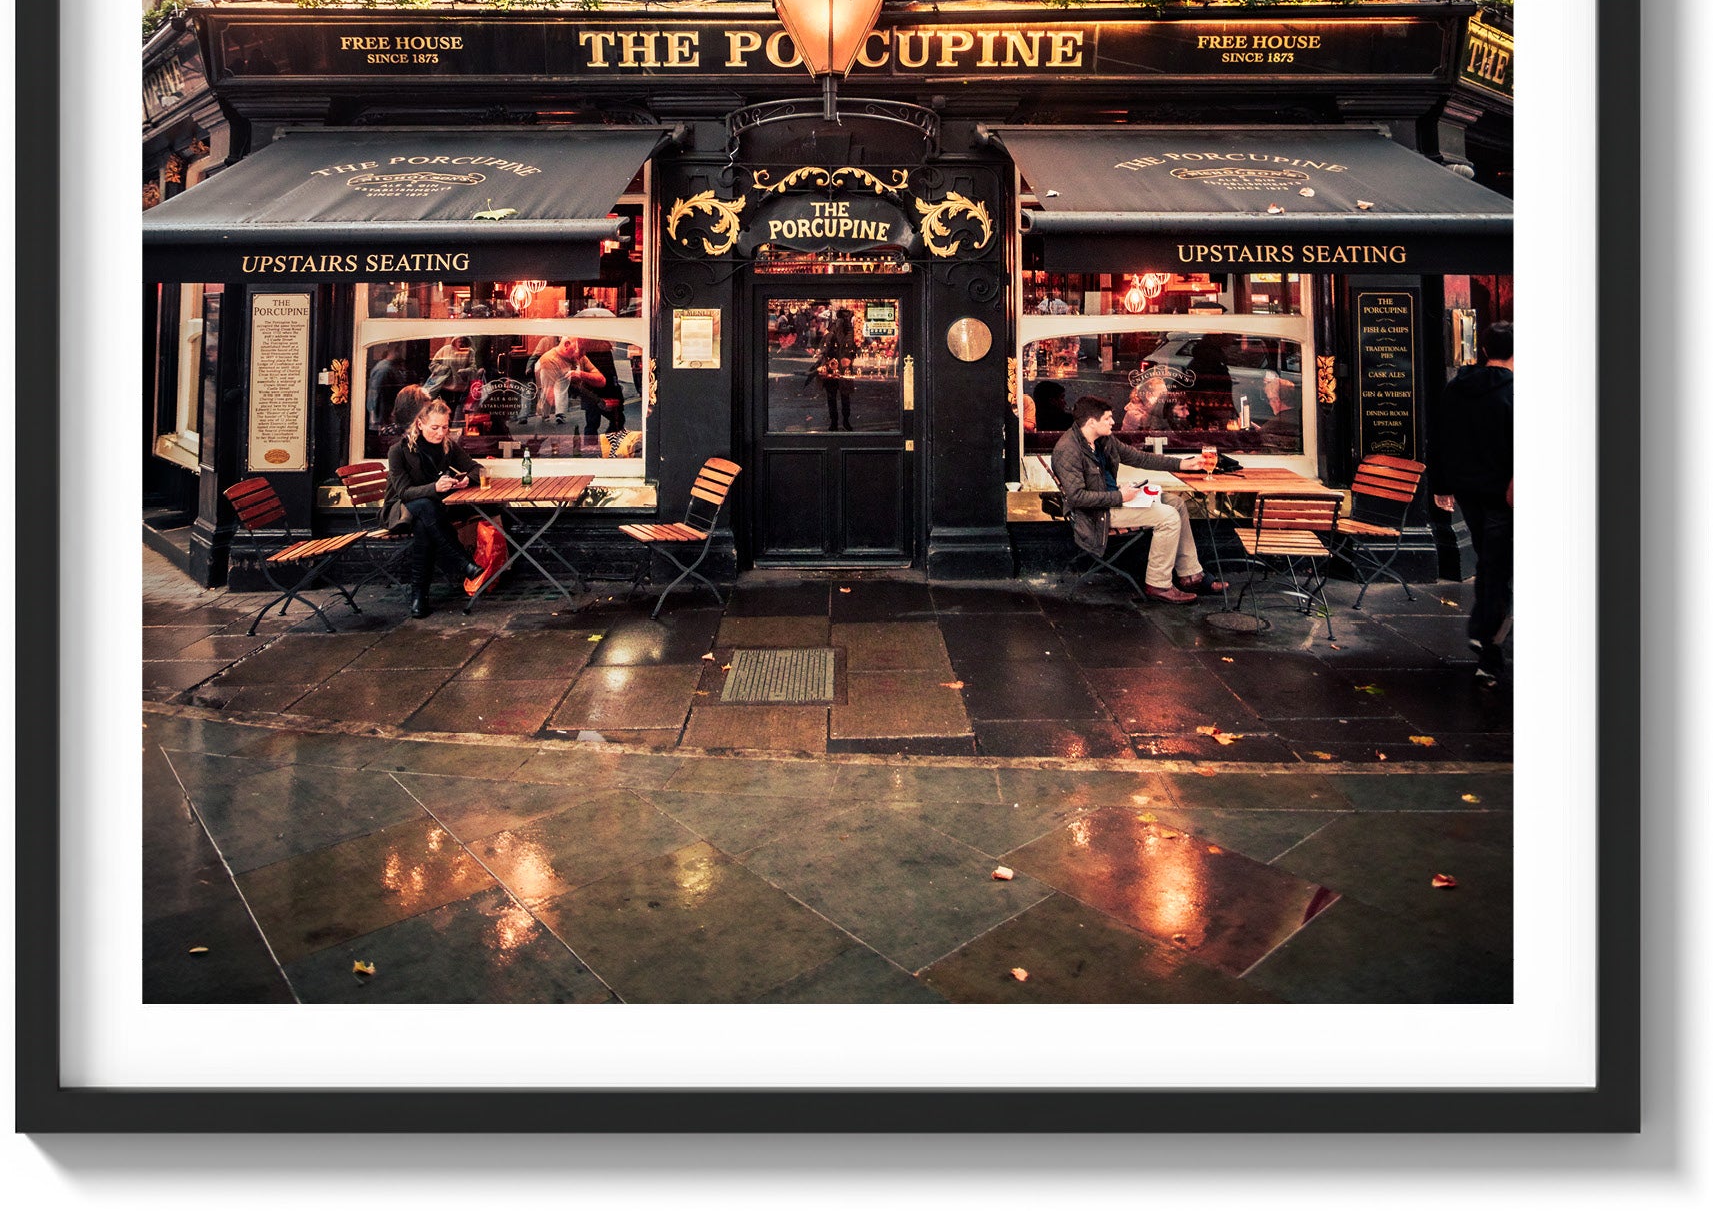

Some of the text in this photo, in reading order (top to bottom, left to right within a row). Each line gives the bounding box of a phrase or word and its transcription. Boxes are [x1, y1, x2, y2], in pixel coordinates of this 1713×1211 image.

[340, 36, 464, 50] FREE HOUSE
[579, 30, 1084, 68] THE POCUPINE
[1196, 35, 1321, 49] FREE HOUSE
[367, 53, 439, 64] SINCE 1873
[1221, 52, 1294, 63] SINCE 1873
[1466, 35, 1510, 85] THE
[310, 156, 542, 178] THE PORCUPINE
[1114, 152, 1349, 173] THE PORCUPINE
[810, 201, 850, 217] THE
[768, 218, 891, 242] PORCUPINE
[1177, 244, 1407, 264] UPSTAIRS SEATING
[242, 252, 470, 273] UPSTAIRS SEATING
[272, 299, 291, 307] THE
[1363, 306, 1408, 314] PORCUPINE
[254, 307, 309, 316] PORCUPINE
[1135, 371, 1190, 383] NICHOLSON'S
[1384, 390, 1412, 398] WHISKY
